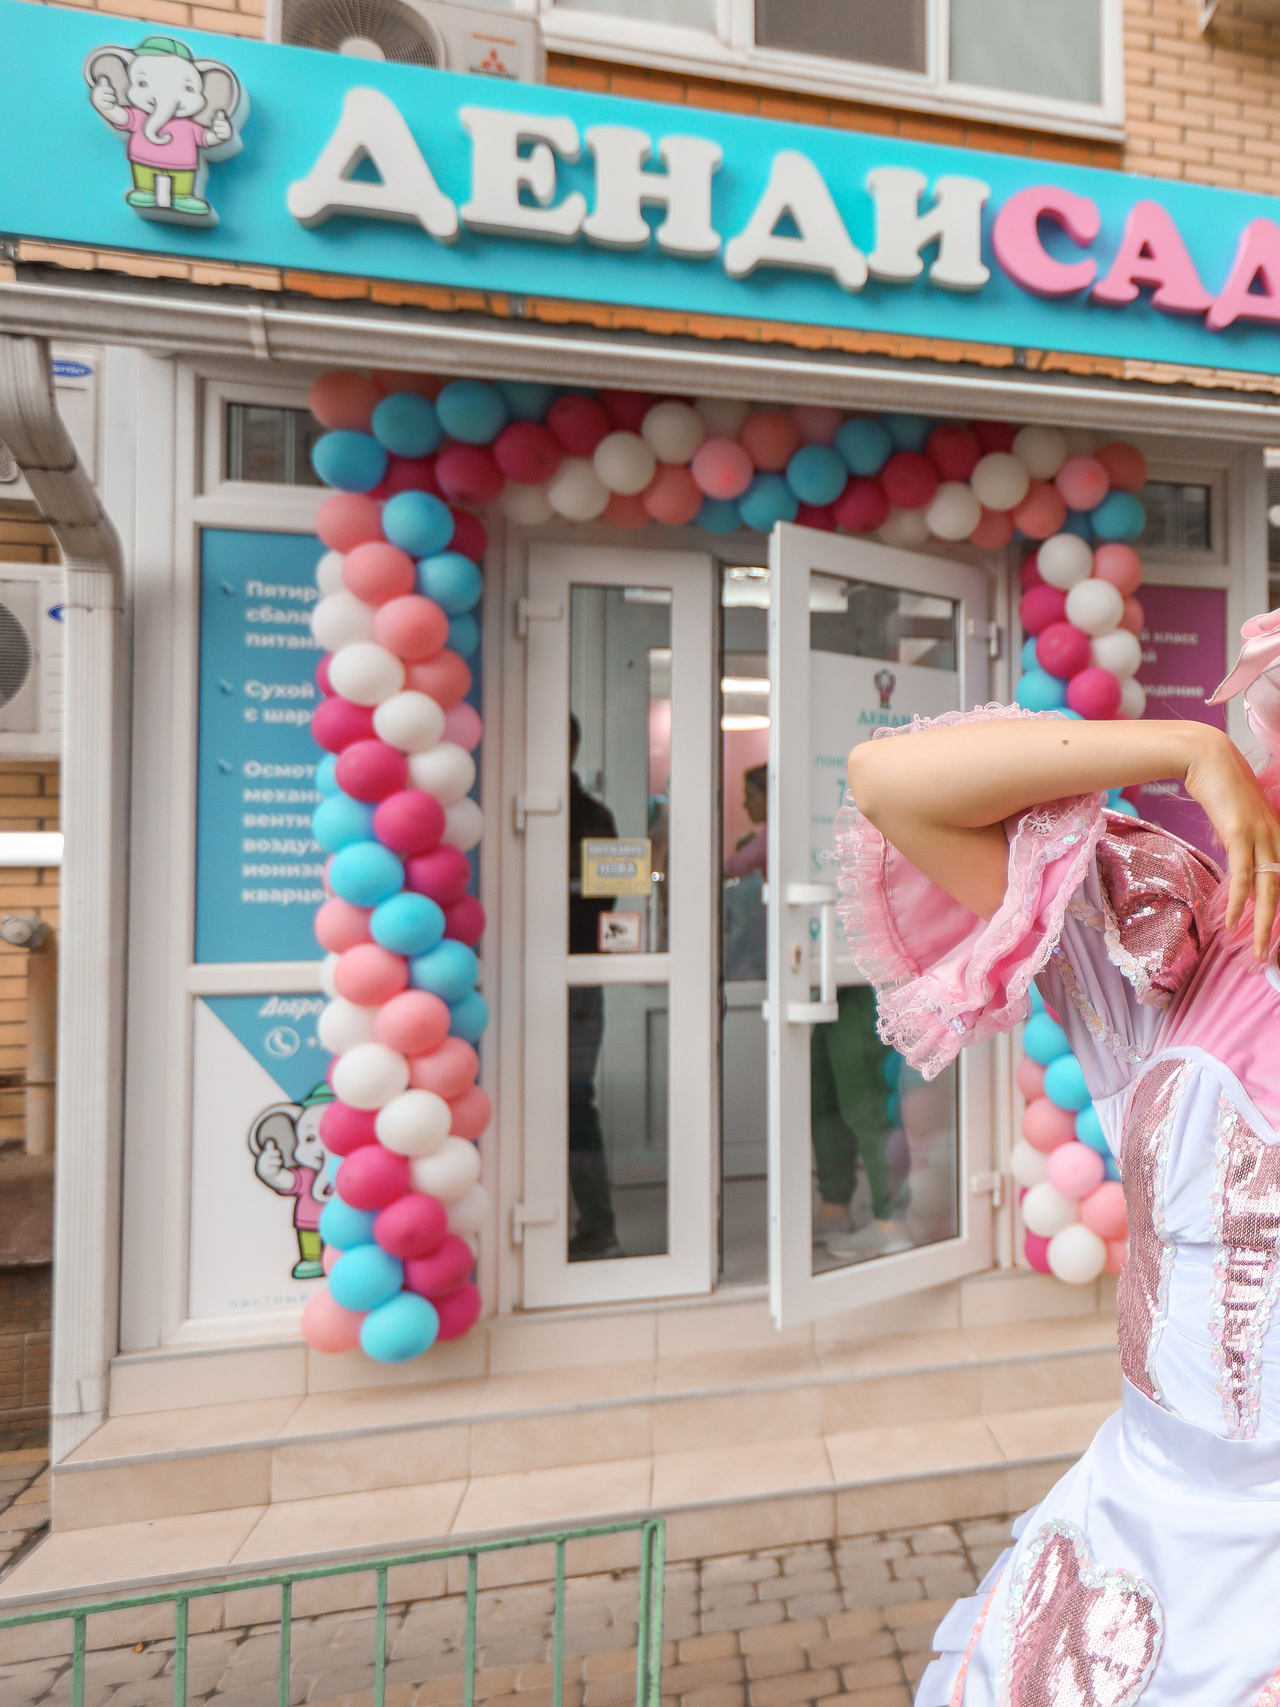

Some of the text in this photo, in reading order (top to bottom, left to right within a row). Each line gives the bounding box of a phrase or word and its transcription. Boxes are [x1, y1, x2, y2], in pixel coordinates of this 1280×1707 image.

[246, 605, 313, 624] сбала
[1154, 632, 1199, 646] класс
[244, 680, 315, 701] Сухой
[1144, 685, 1204, 698] юдение
[244, 707, 312, 727] с шар
[243, 760, 317, 779] Осмот
[243, 814, 311, 829] венти
[243, 838, 326, 856] воздух
[242, 863, 326, 880] иониза
[242, 888, 329, 907] кварце
[258, 996, 325, 1021] Добро
